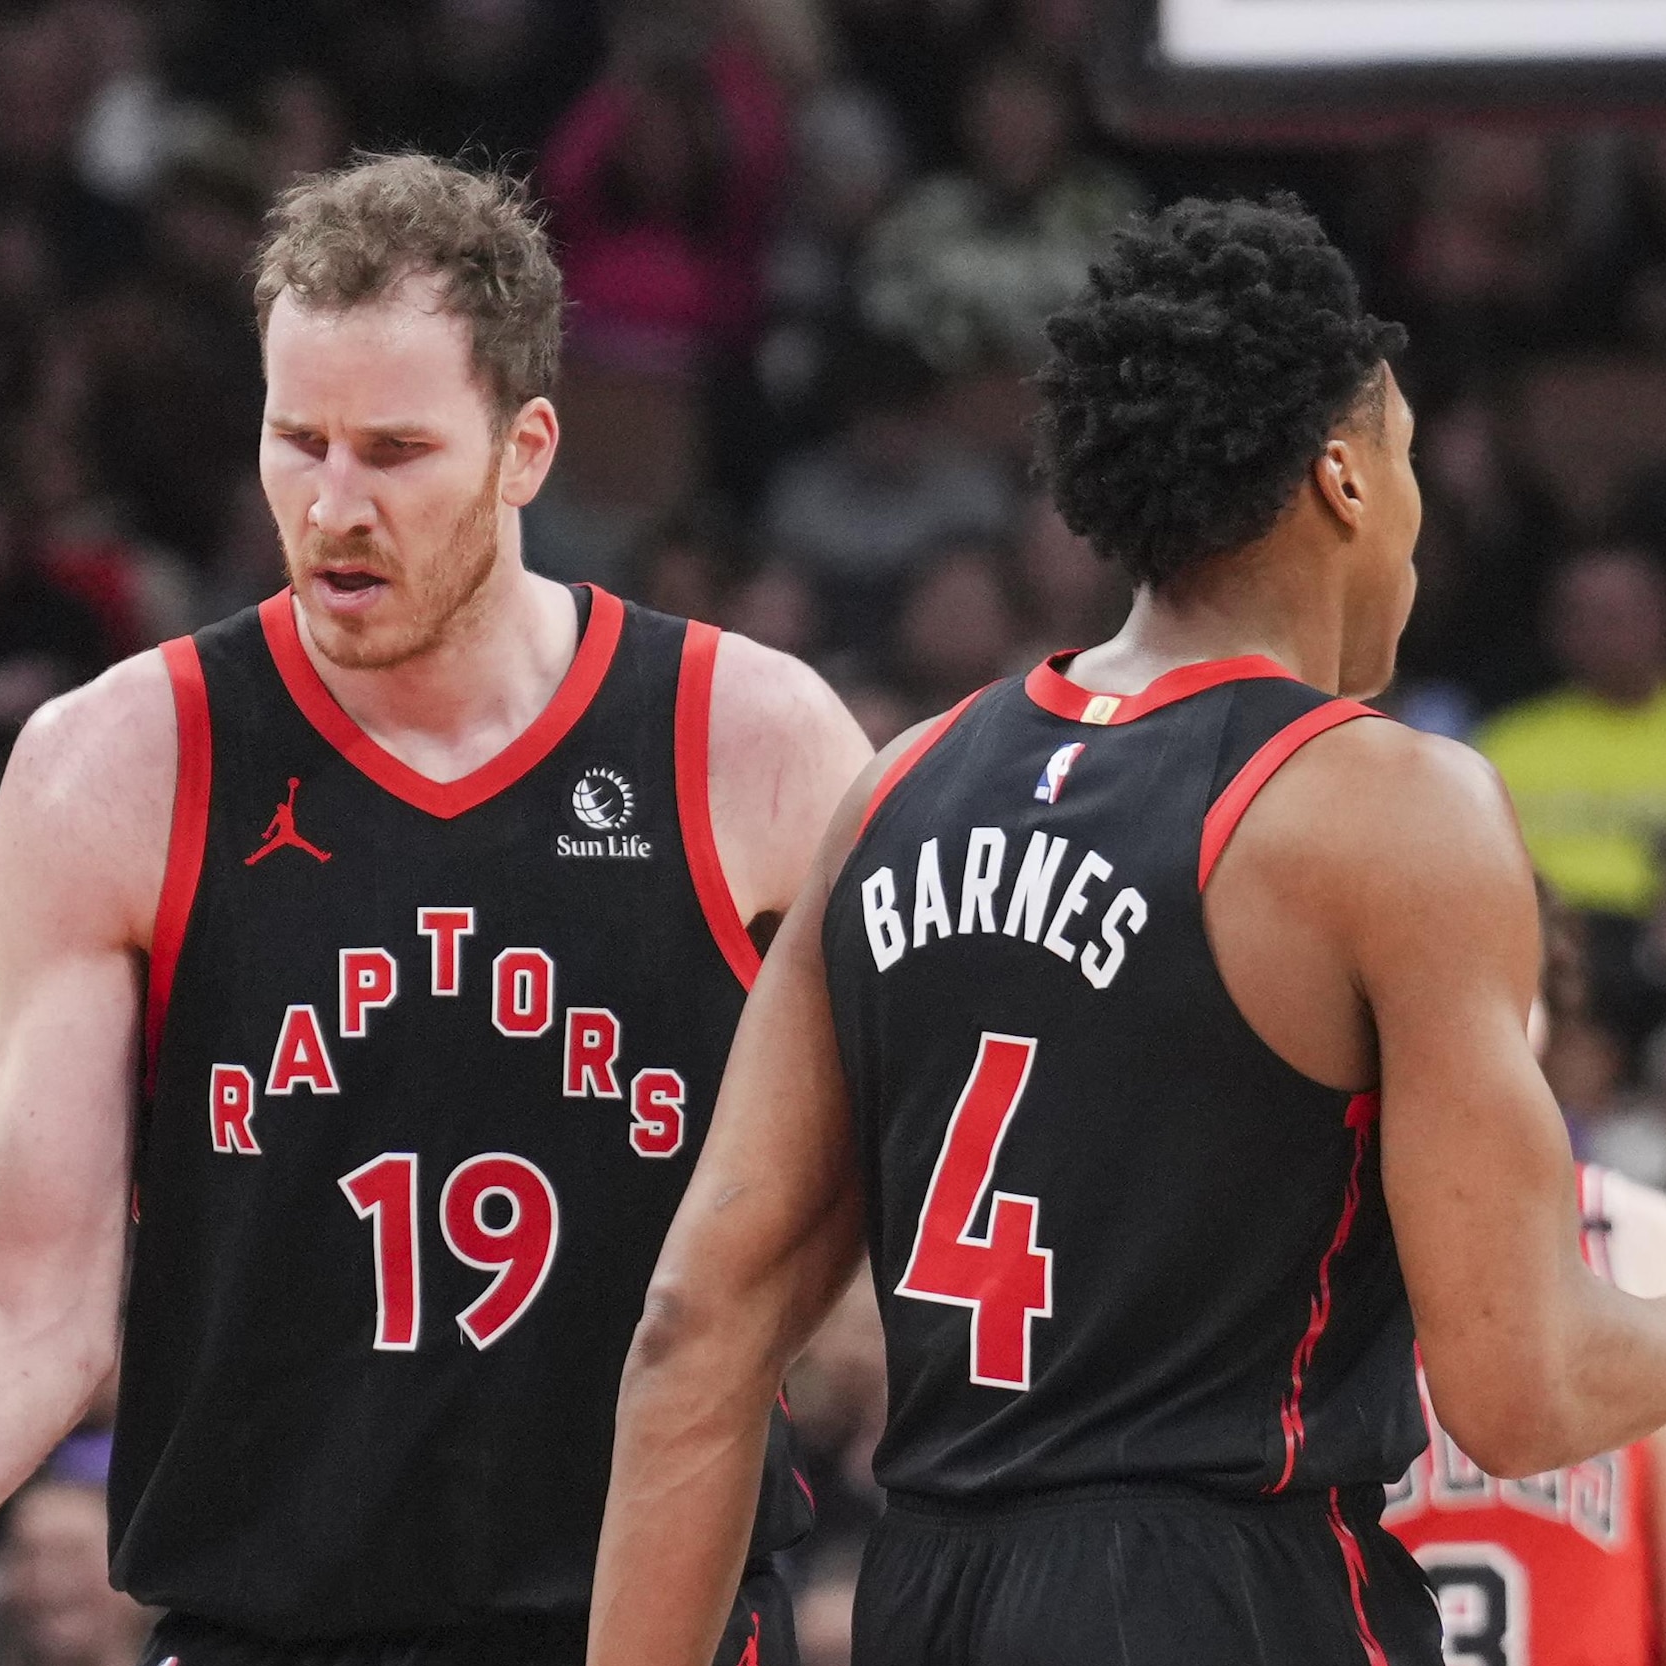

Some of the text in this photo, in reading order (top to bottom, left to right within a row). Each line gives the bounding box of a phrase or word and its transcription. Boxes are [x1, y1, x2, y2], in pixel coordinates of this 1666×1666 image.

[557, 834, 652, 857] Sun Life
[861, 827, 1147, 989] BARNES
[210, 906, 685, 1157] RAPTORS
[338, 1152, 559, 1351] 19
[894, 1031, 1053, 1391] 4
